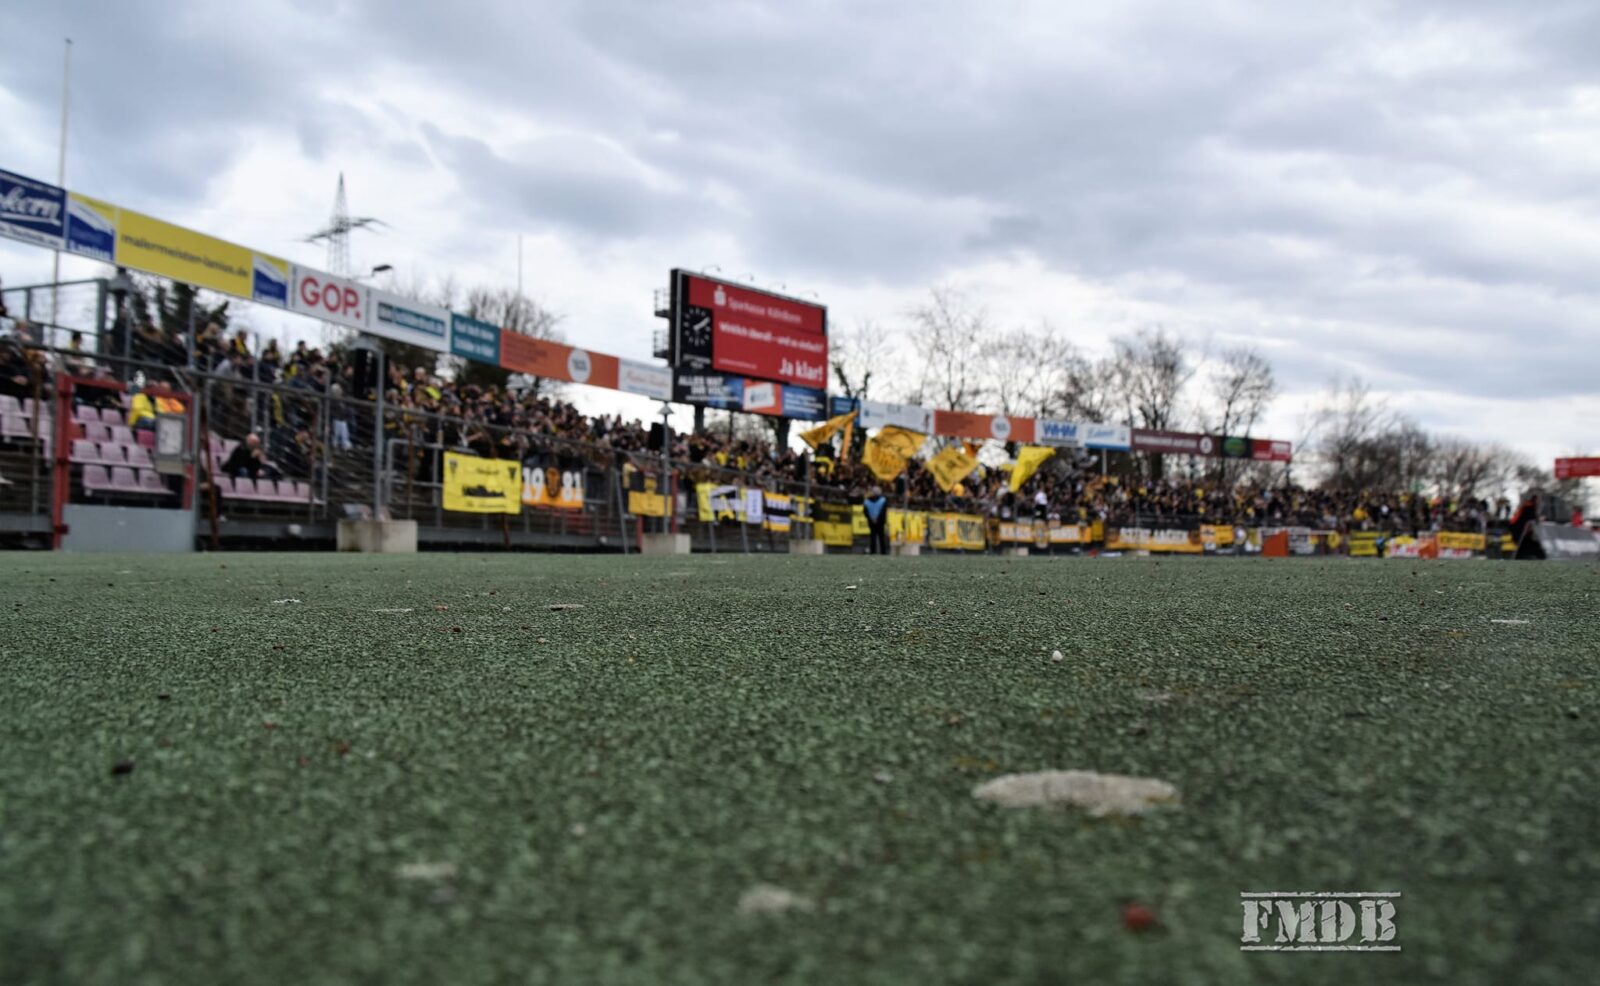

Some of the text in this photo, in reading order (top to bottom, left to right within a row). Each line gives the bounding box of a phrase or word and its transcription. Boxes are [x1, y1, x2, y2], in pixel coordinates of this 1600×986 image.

[300, 276, 361, 319] GOP.
[779, 358, 793, 377] Ja
[795, 360, 823, 382] klar!
[522, 467, 545, 500] 19
